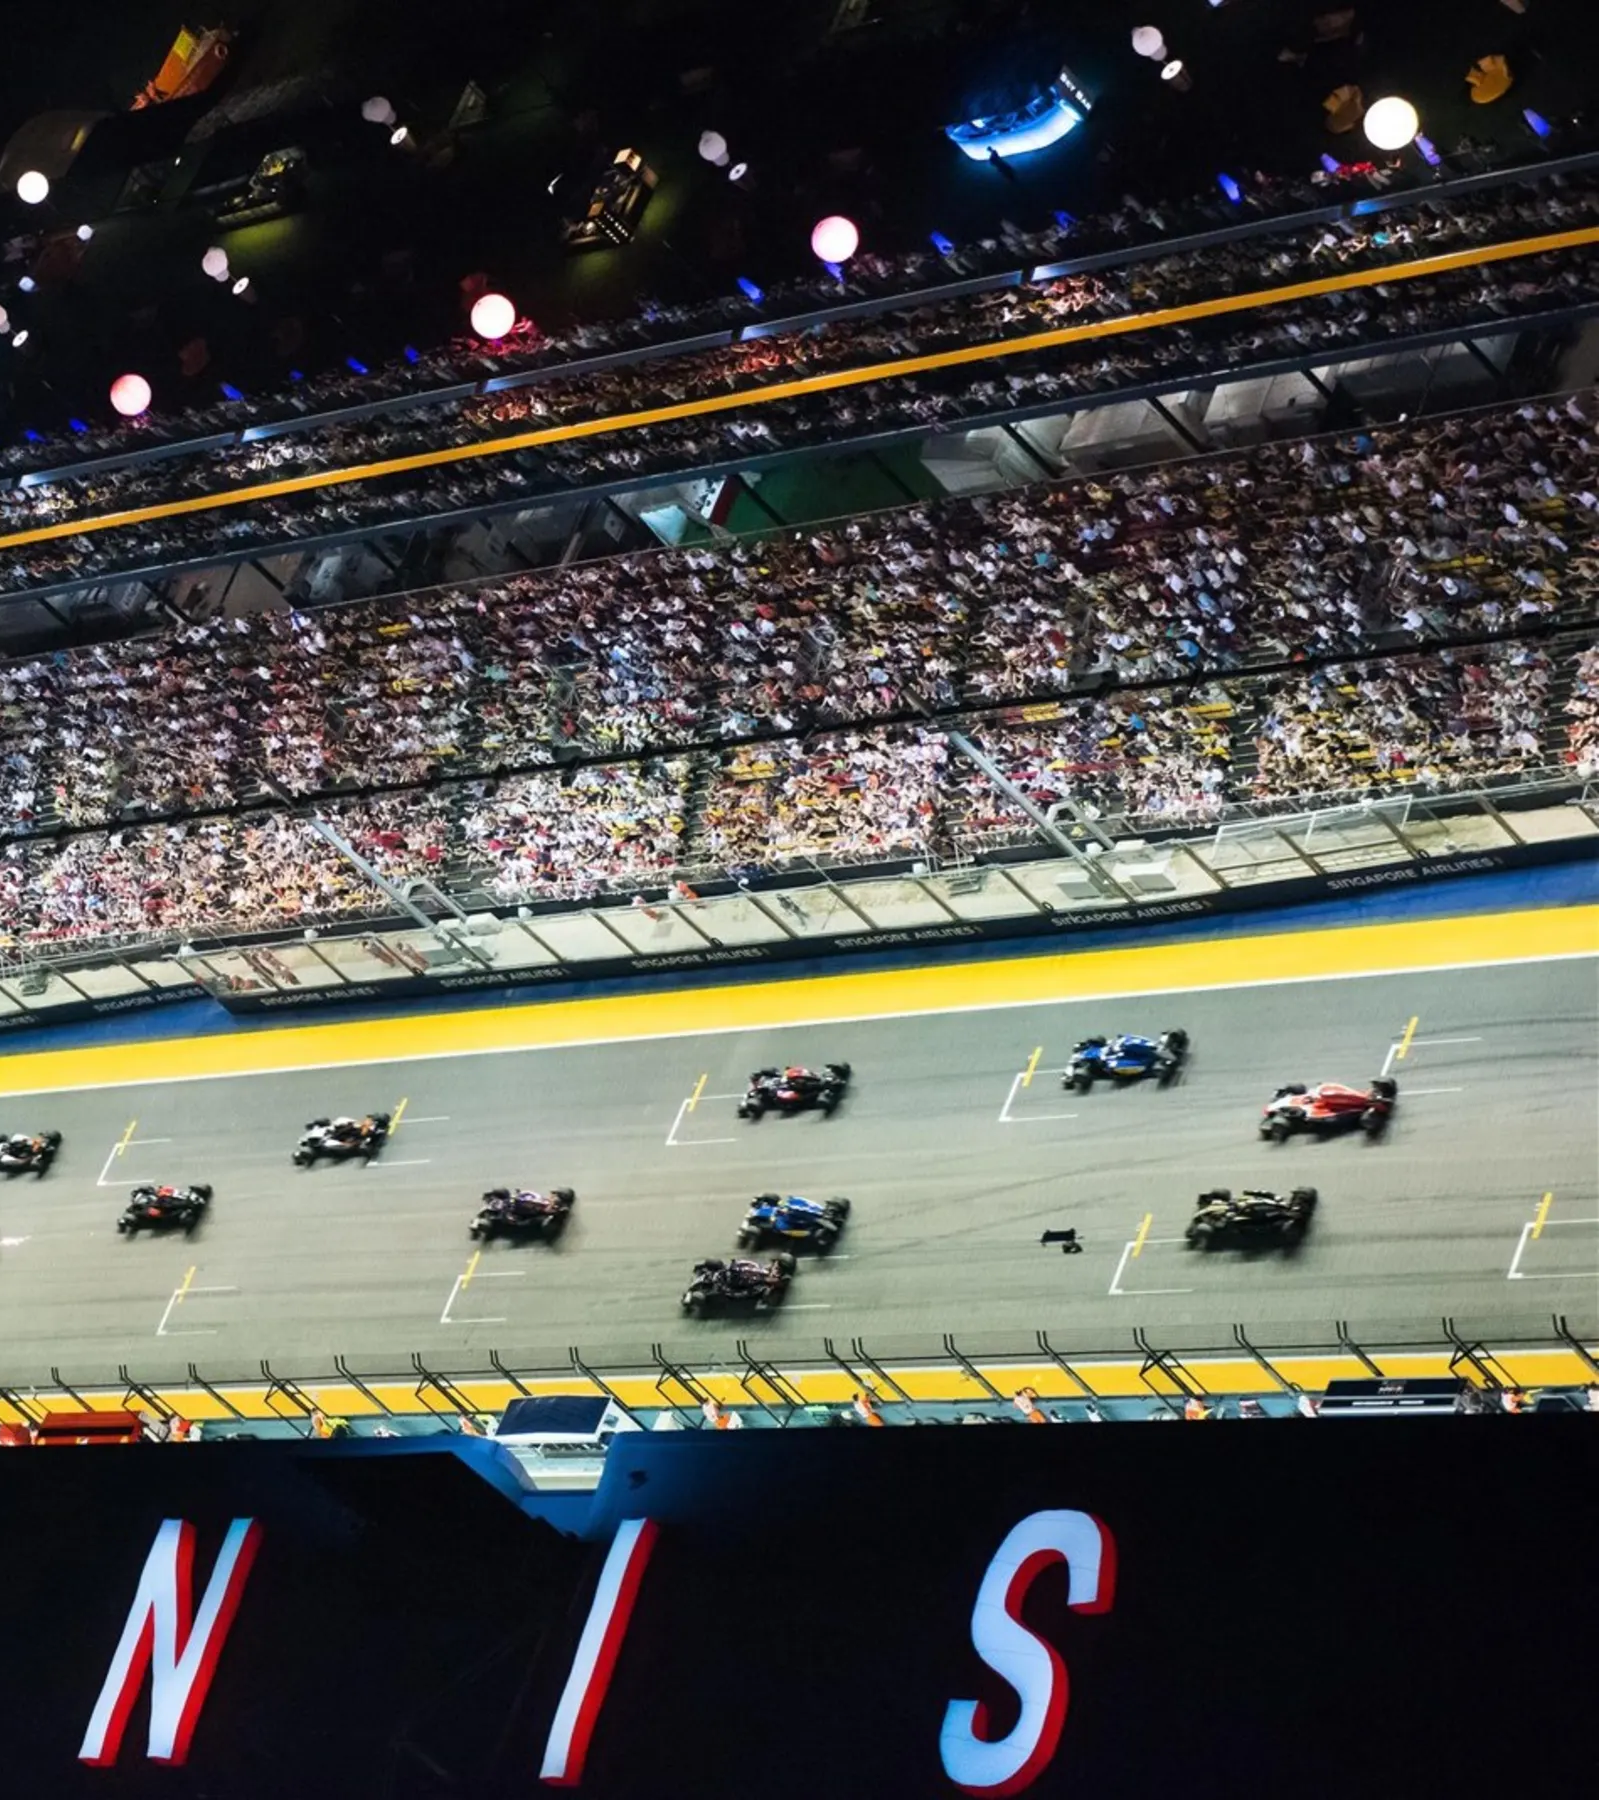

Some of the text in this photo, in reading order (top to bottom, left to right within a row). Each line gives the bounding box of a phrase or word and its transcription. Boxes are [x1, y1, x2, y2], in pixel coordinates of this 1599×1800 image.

[1327, 857, 1494, 890] SINGAPORE AIRLINES
[1051, 901, 1203, 927] SINGAPORE AIRLINES
[834, 926, 974, 948] SINGAPORE AIRLINES
[631, 947, 764, 969] SINGAPORE AIRLINES
[440, 968, 563, 987] SINGAPORE AIRLINES
